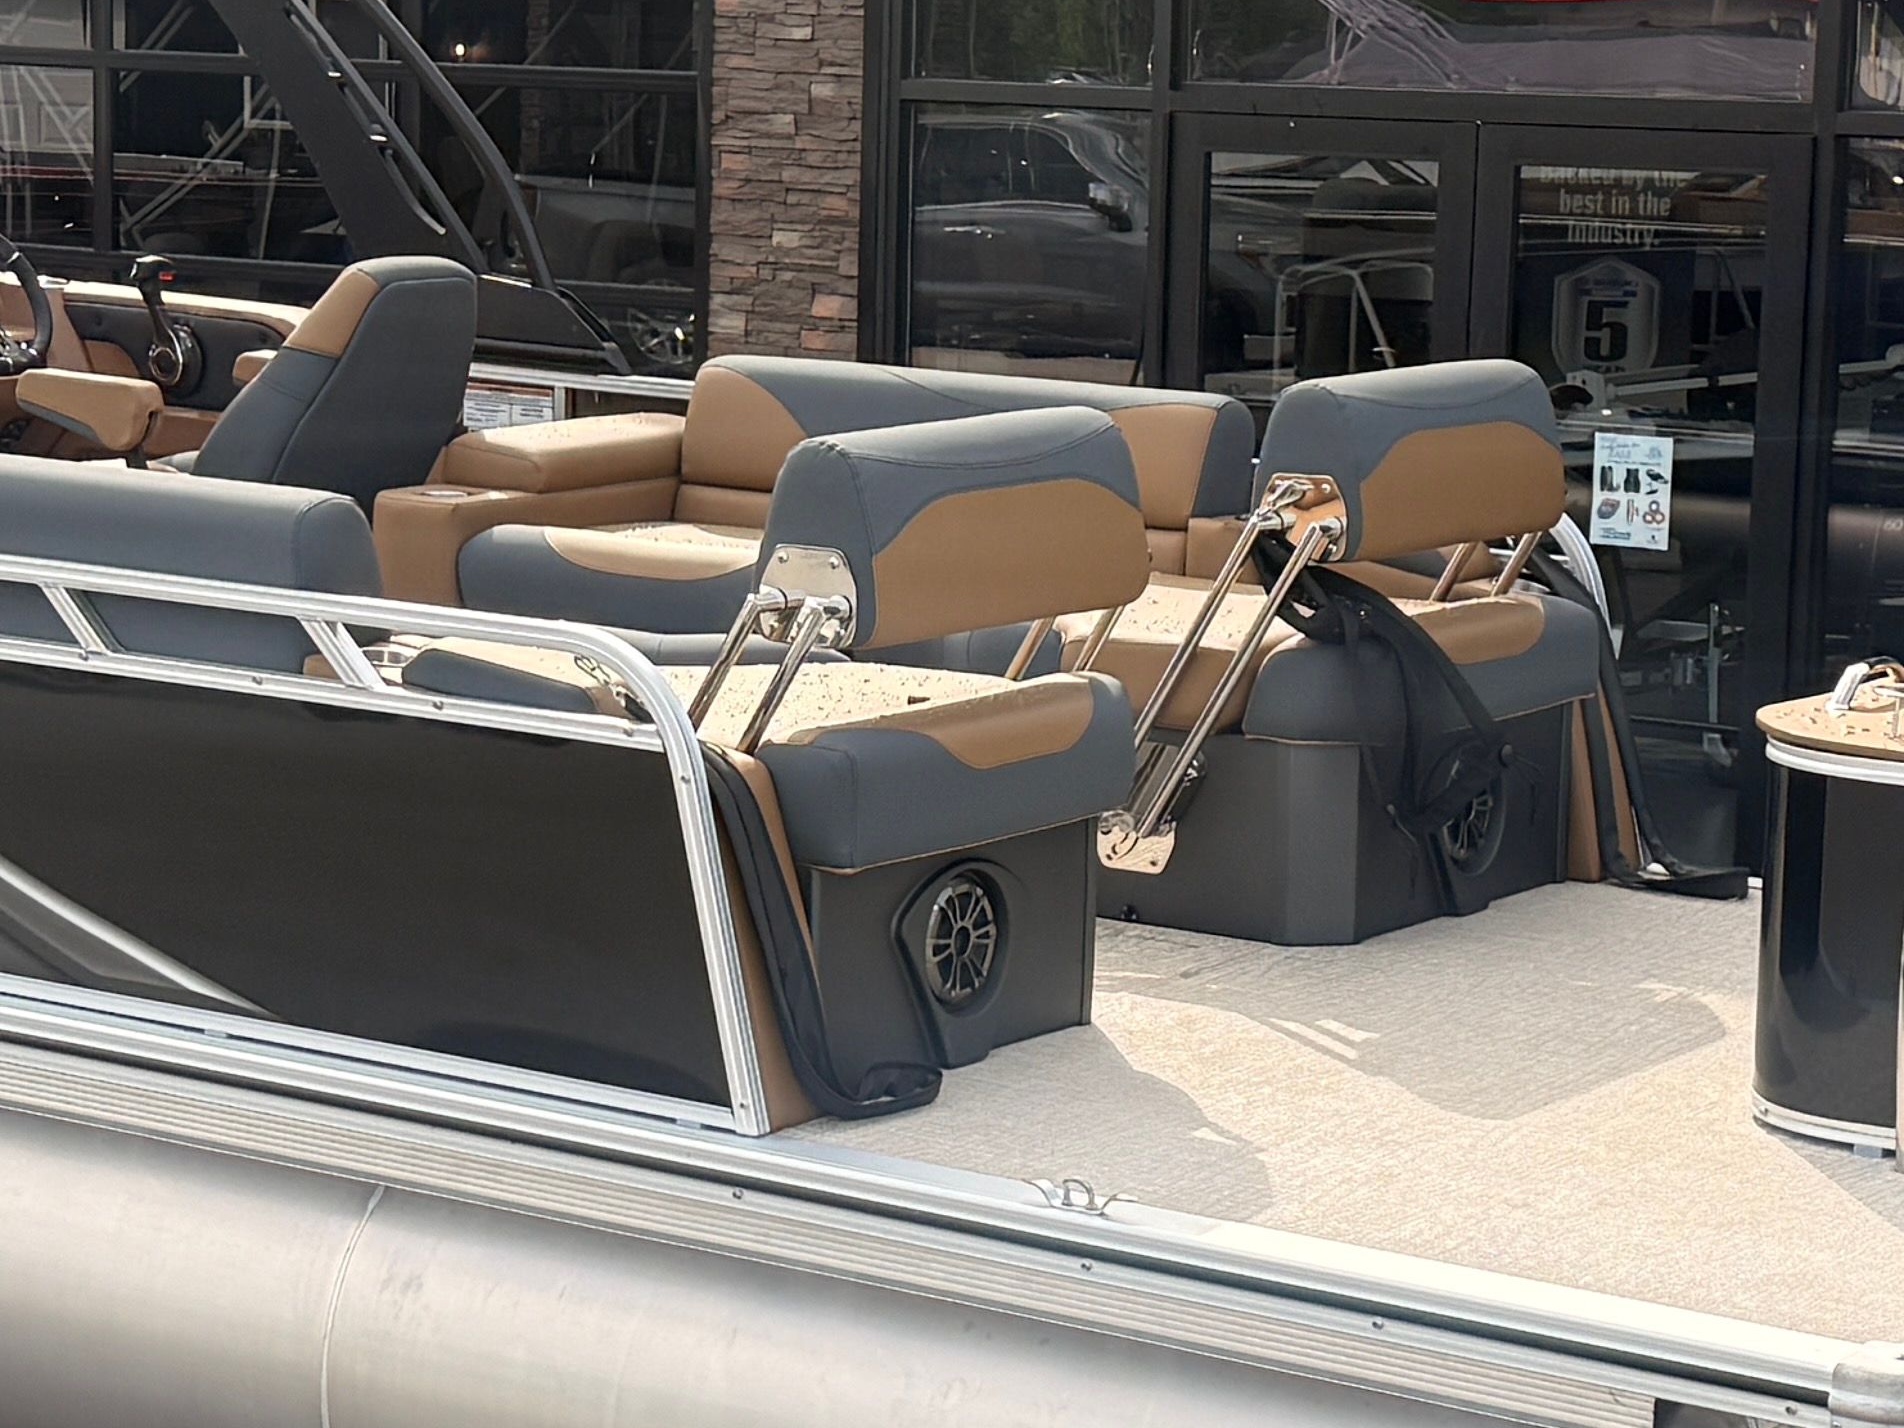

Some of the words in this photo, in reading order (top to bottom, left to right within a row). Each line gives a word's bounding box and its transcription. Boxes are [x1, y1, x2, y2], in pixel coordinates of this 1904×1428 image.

[1559, 188, 1605, 214] best
[1611, 191, 1631, 215] in
[1636, 191, 1672, 217] the
[1583, 300, 1631, 363] 5
